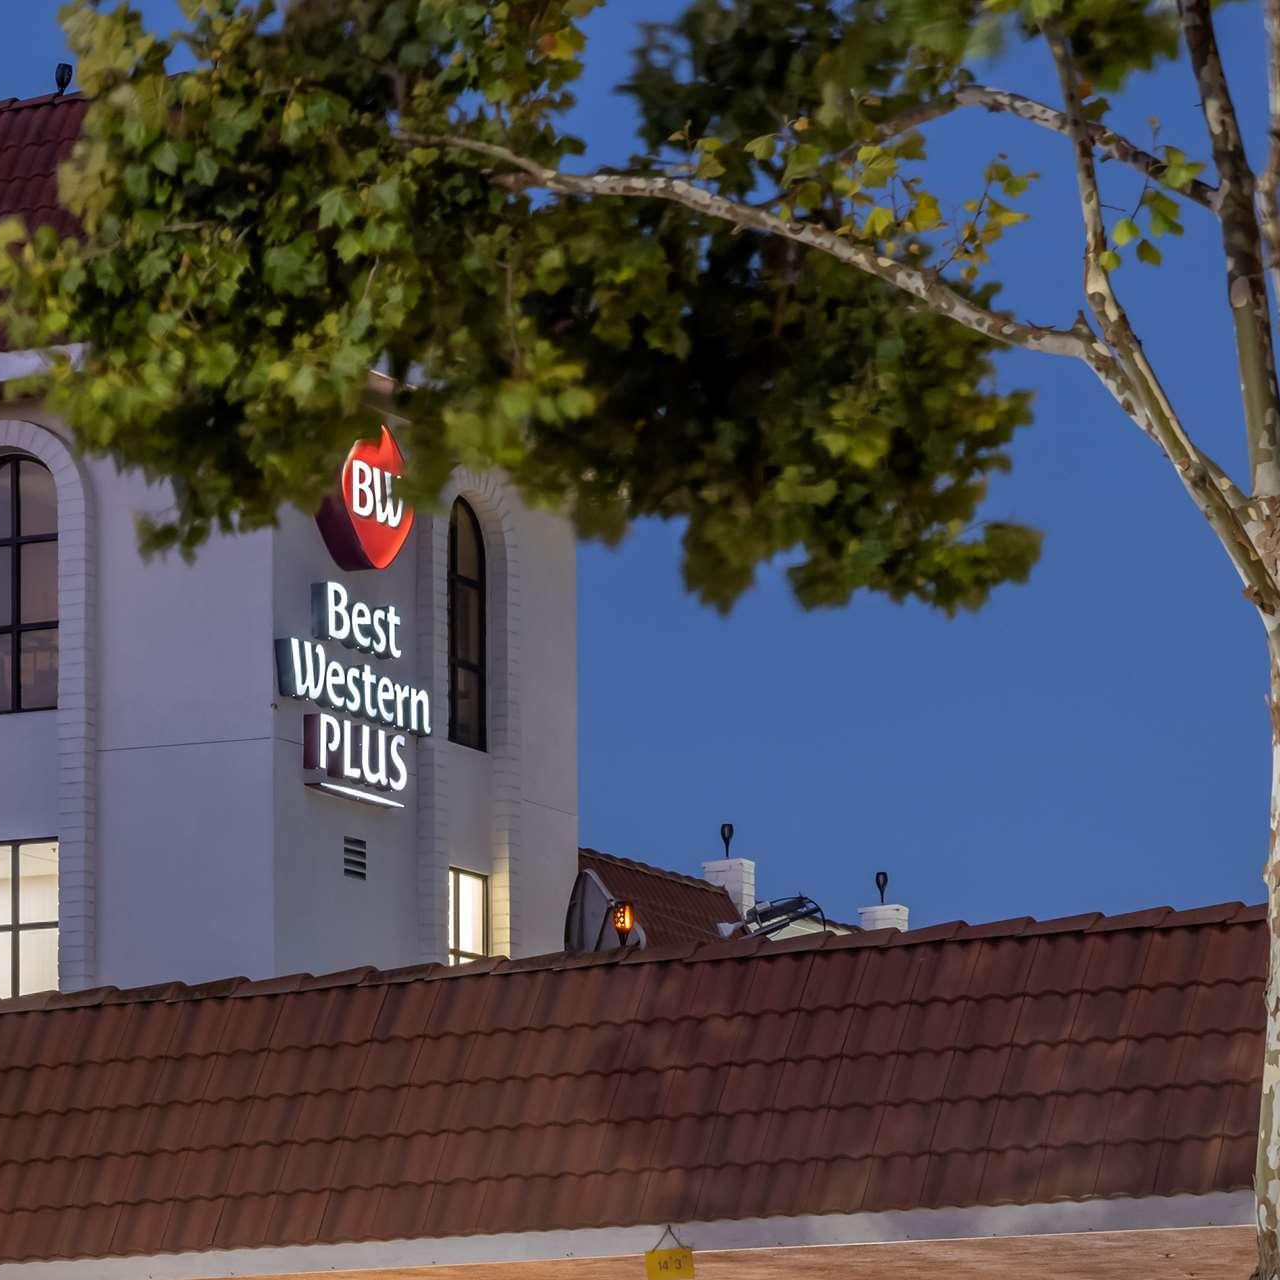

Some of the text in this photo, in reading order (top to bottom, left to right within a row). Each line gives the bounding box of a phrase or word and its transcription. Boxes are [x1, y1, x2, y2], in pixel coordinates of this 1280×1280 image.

[353, 459, 404, 528] BW
[327, 581, 401, 659] Best
[291, 638, 431, 735] Western
[320, 713, 407, 791] PLUS
